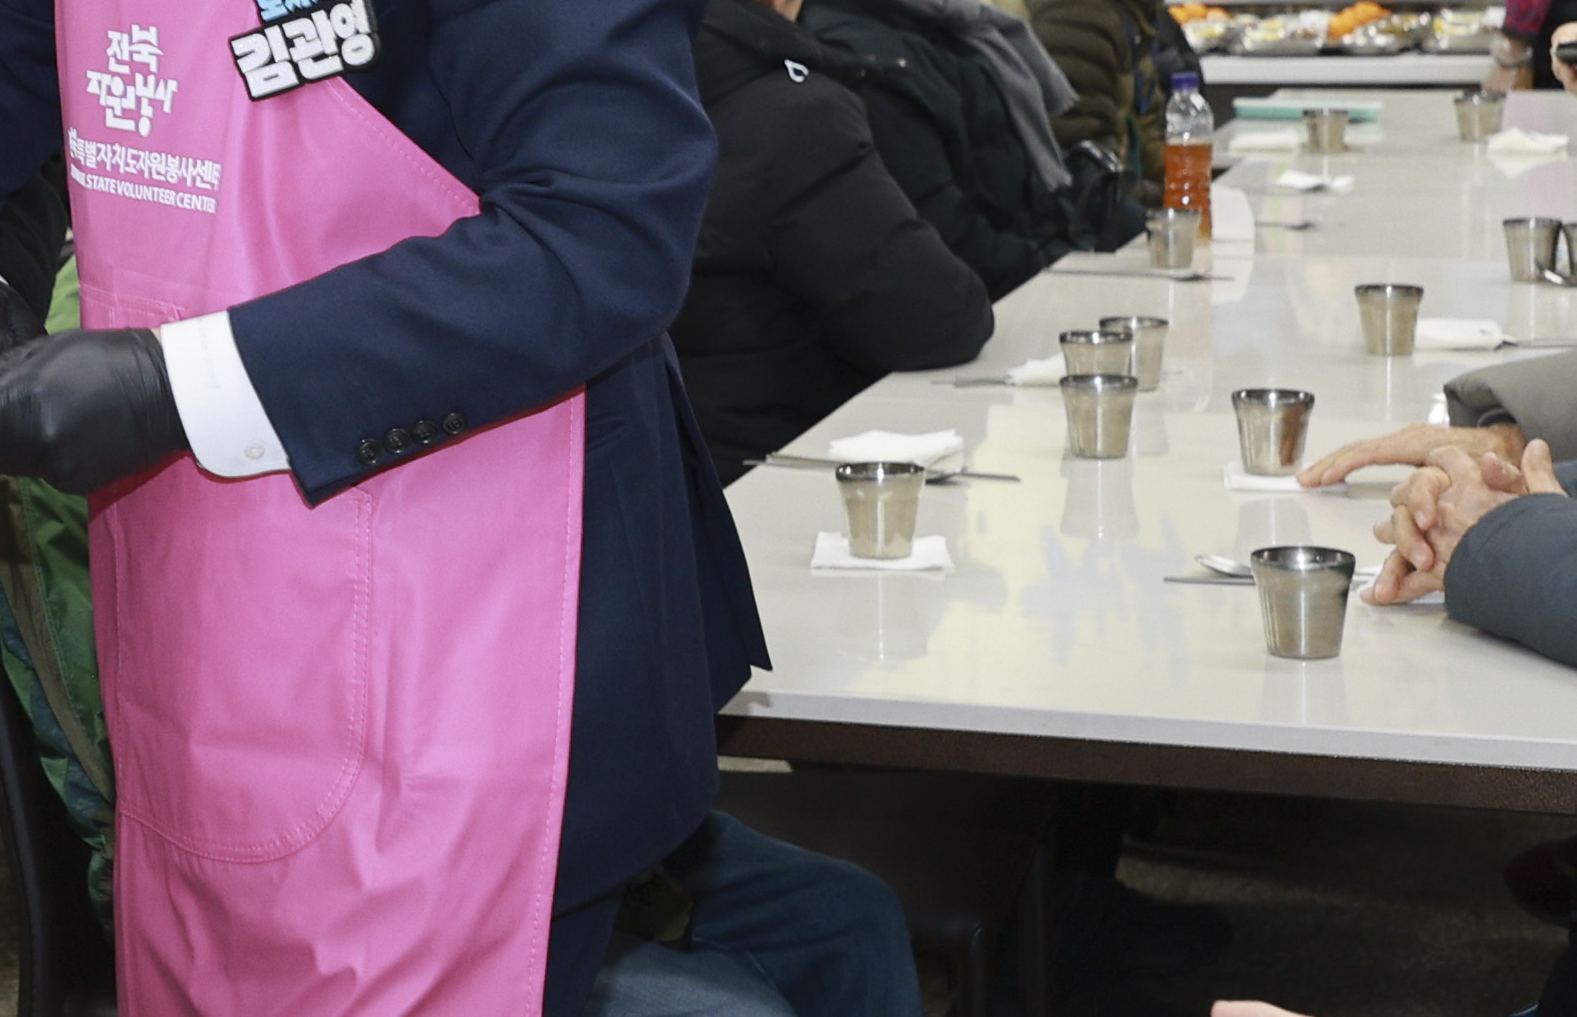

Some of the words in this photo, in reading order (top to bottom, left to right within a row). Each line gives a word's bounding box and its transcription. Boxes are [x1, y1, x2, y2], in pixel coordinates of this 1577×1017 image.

[106, 23, 165, 75] 전북
[85, 69, 180, 139] 자원봉사
[86, 172, 119, 196] STATE
[115, 179, 177, 207] VOLUNTEER
